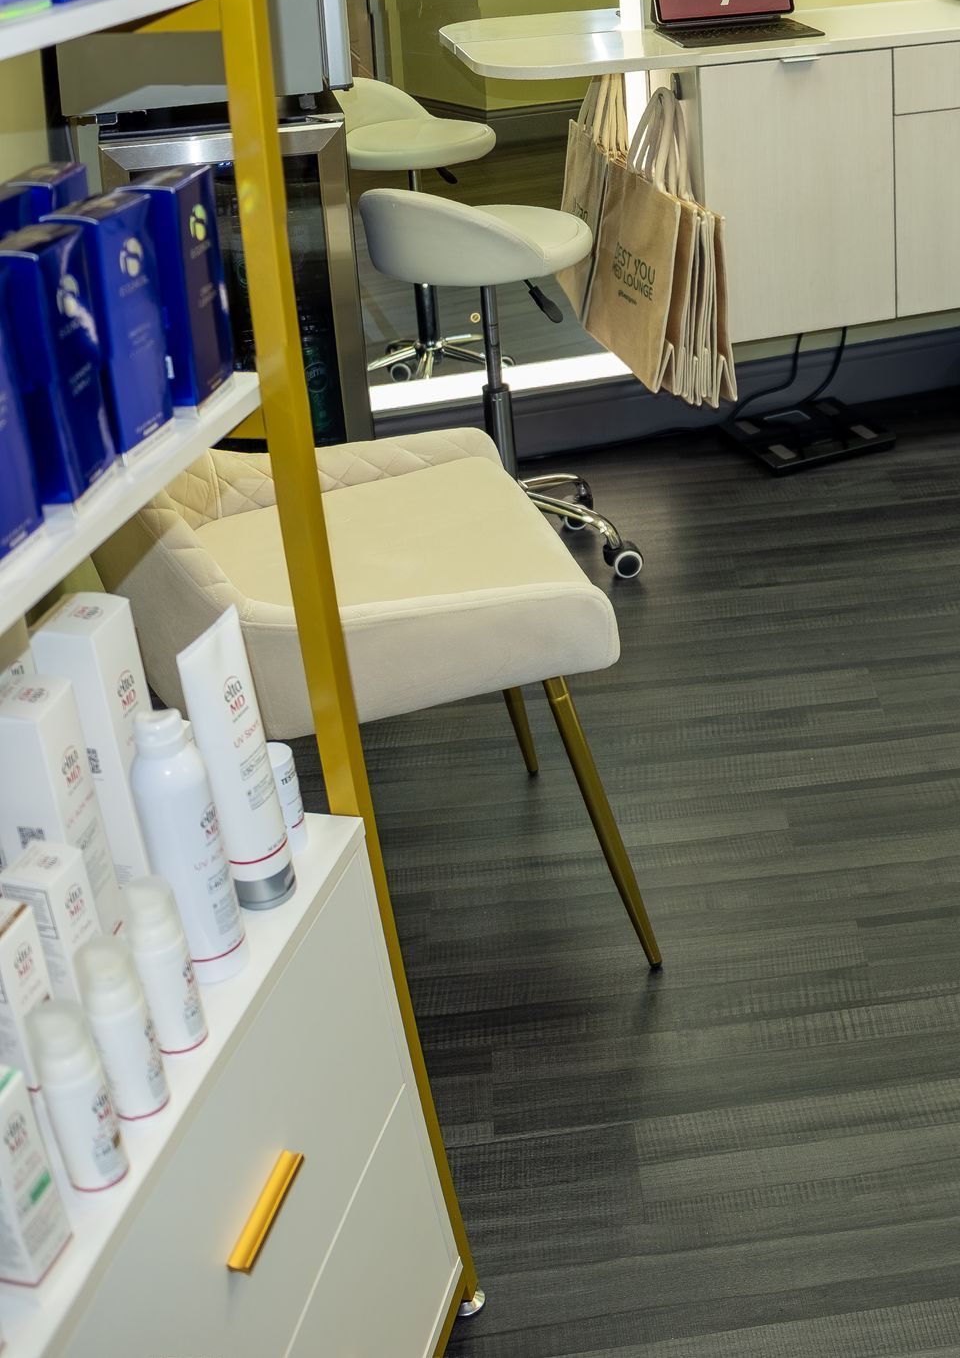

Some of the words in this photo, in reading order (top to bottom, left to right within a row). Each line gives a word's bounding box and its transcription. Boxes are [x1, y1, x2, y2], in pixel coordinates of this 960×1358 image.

[634, 257, 656, 286] YOU
[623, 271, 654, 302] LOUNGE
[224, 679, 243, 703] elta
[229, 693, 247, 716] MD
